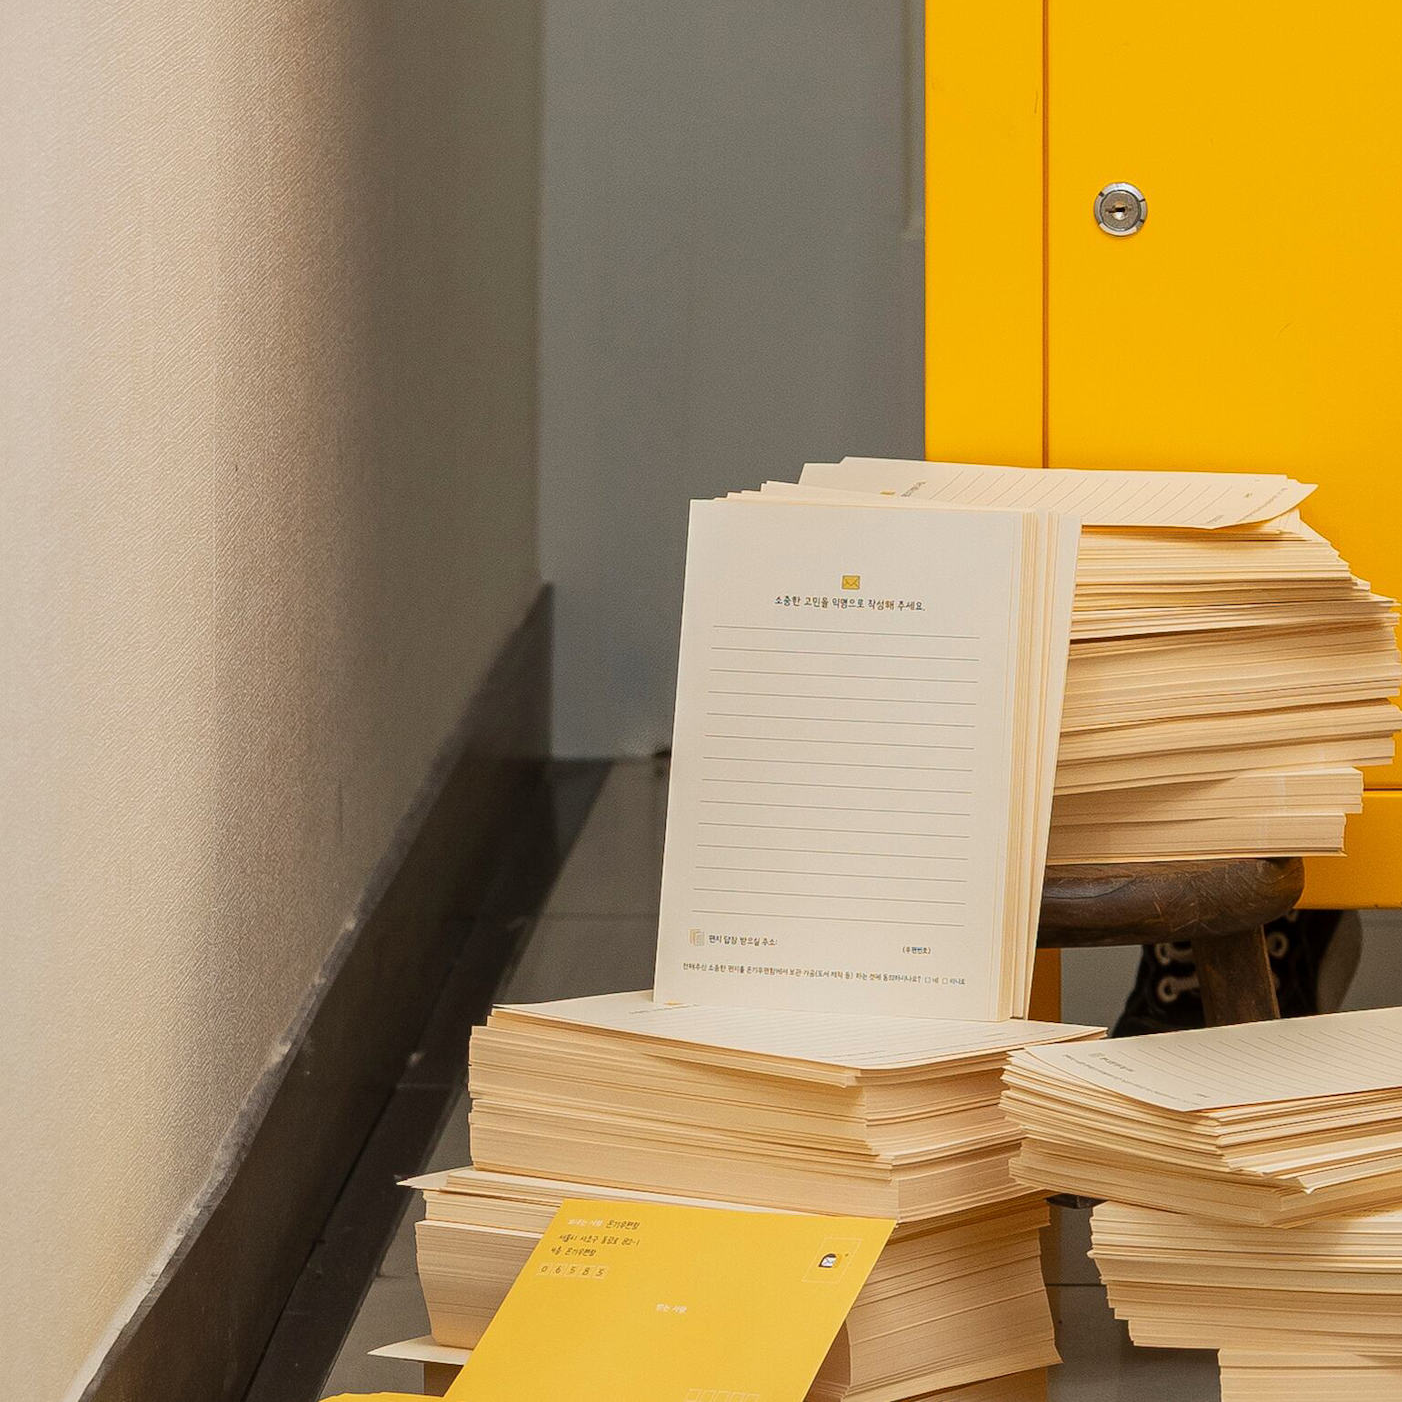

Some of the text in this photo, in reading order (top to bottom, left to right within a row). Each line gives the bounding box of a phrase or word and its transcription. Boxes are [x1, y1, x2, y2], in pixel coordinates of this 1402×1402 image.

[774, 595, 926, 611] 소중한 고민을 익명으로 작성해 주세요.
[708, 934, 722, 944] 편지
[740, 936, 760, 947] 받으실
